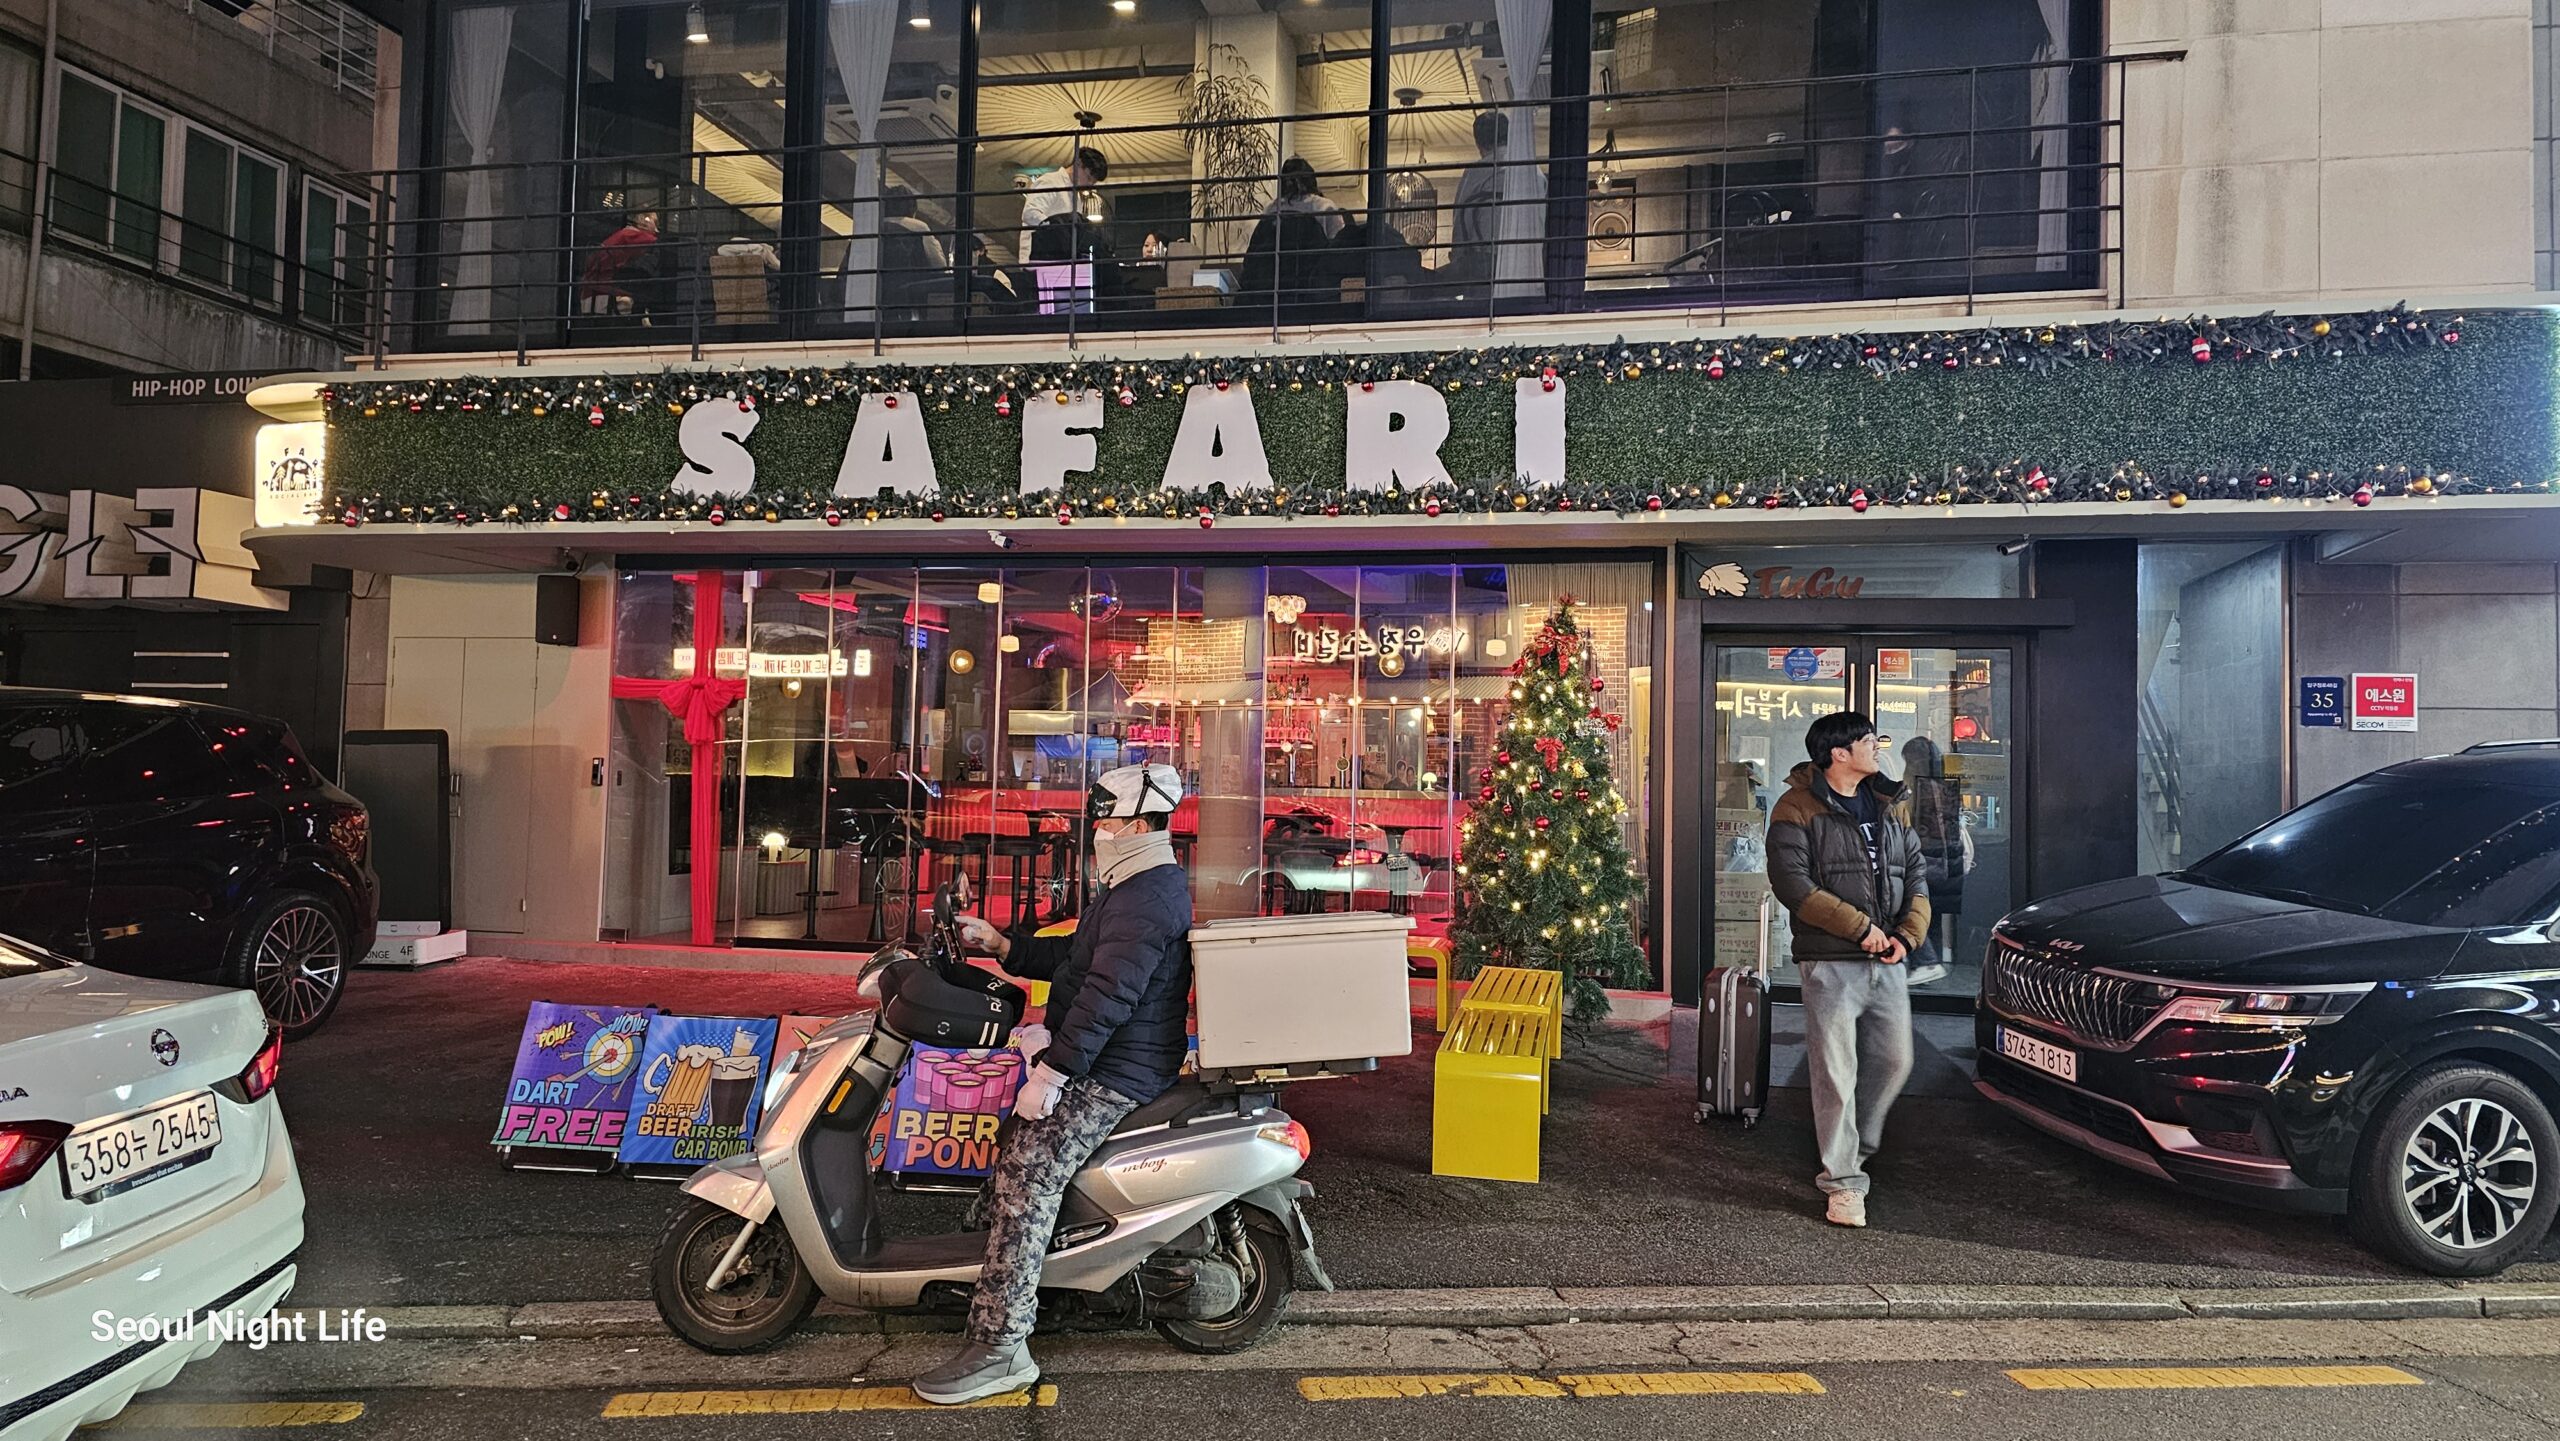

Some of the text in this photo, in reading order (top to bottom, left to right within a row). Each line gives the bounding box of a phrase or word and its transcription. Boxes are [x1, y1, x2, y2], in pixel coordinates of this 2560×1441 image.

[132, 377, 261, 397] HIP-HOP LOU
[671, 377, 1566, 500] SAFARI
[2311, 693, 2334, 708] 35
[2365, 688, 2405, 703] 에스원
[400, 945, 414, 956] 4F
[609, 1014, 649, 1034] WOW!
[538, 1021, 574, 1049] POW!
[2005, 1032, 2071, 1076] 376조 1813
[511, 1079, 580, 1106] DART
[646, 1102, 696, 1117] DRAFT
[500, 1104, 629, 1147] FREE
[637, 1116, 693, 1137] BEER
[689, 1124, 740, 1139] IRISH
[895, 1110, 1000, 1144] BEER
[77, 1104, 212, 1183] 358누 2545
[673, 1138, 749, 1160] CAR BOMB
